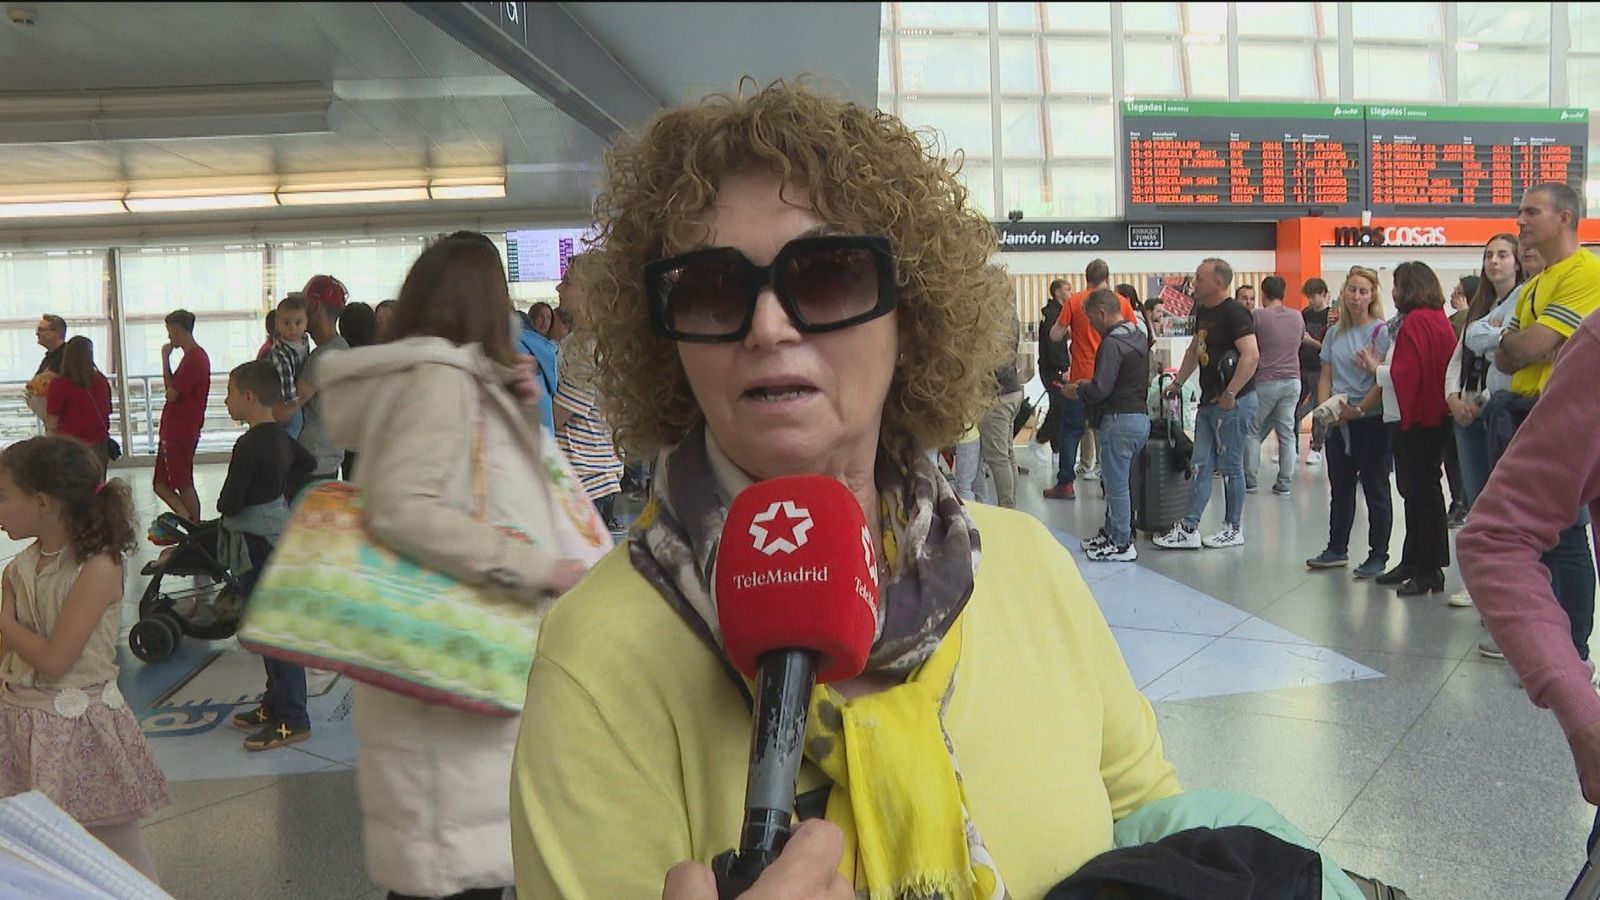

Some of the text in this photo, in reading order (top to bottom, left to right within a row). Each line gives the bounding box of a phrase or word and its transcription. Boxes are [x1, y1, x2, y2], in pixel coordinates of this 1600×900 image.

[1127, 102, 1163, 113] Llegadas
[1371, 108, 1403, 118] Llegadas
[999, 230, 1100, 245] Jamón Ibérico
[732, 566, 828, 590] TeleMadrid
